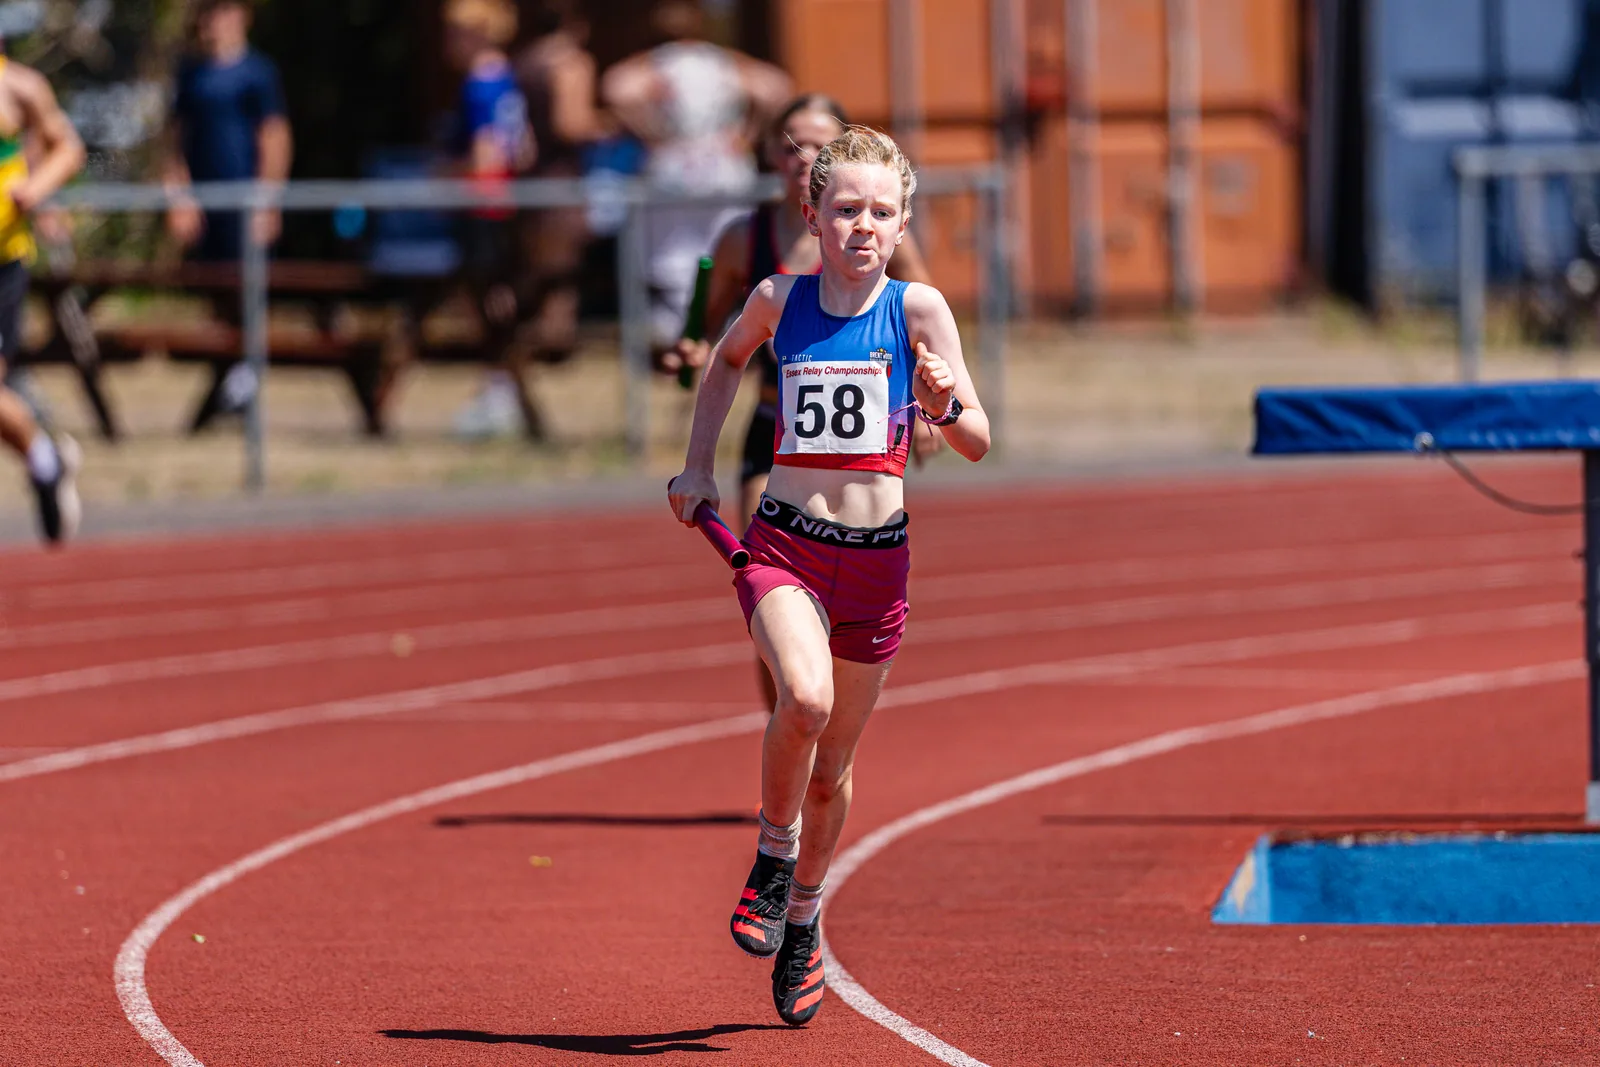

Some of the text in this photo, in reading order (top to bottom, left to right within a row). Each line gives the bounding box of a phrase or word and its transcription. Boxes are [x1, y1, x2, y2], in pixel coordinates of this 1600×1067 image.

[786, 366, 883, 379] Essex Relay Championships
[794, 384, 866, 440] 58
[760, 496, 780, 516] O
[790, 513, 870, 543] NIKE
